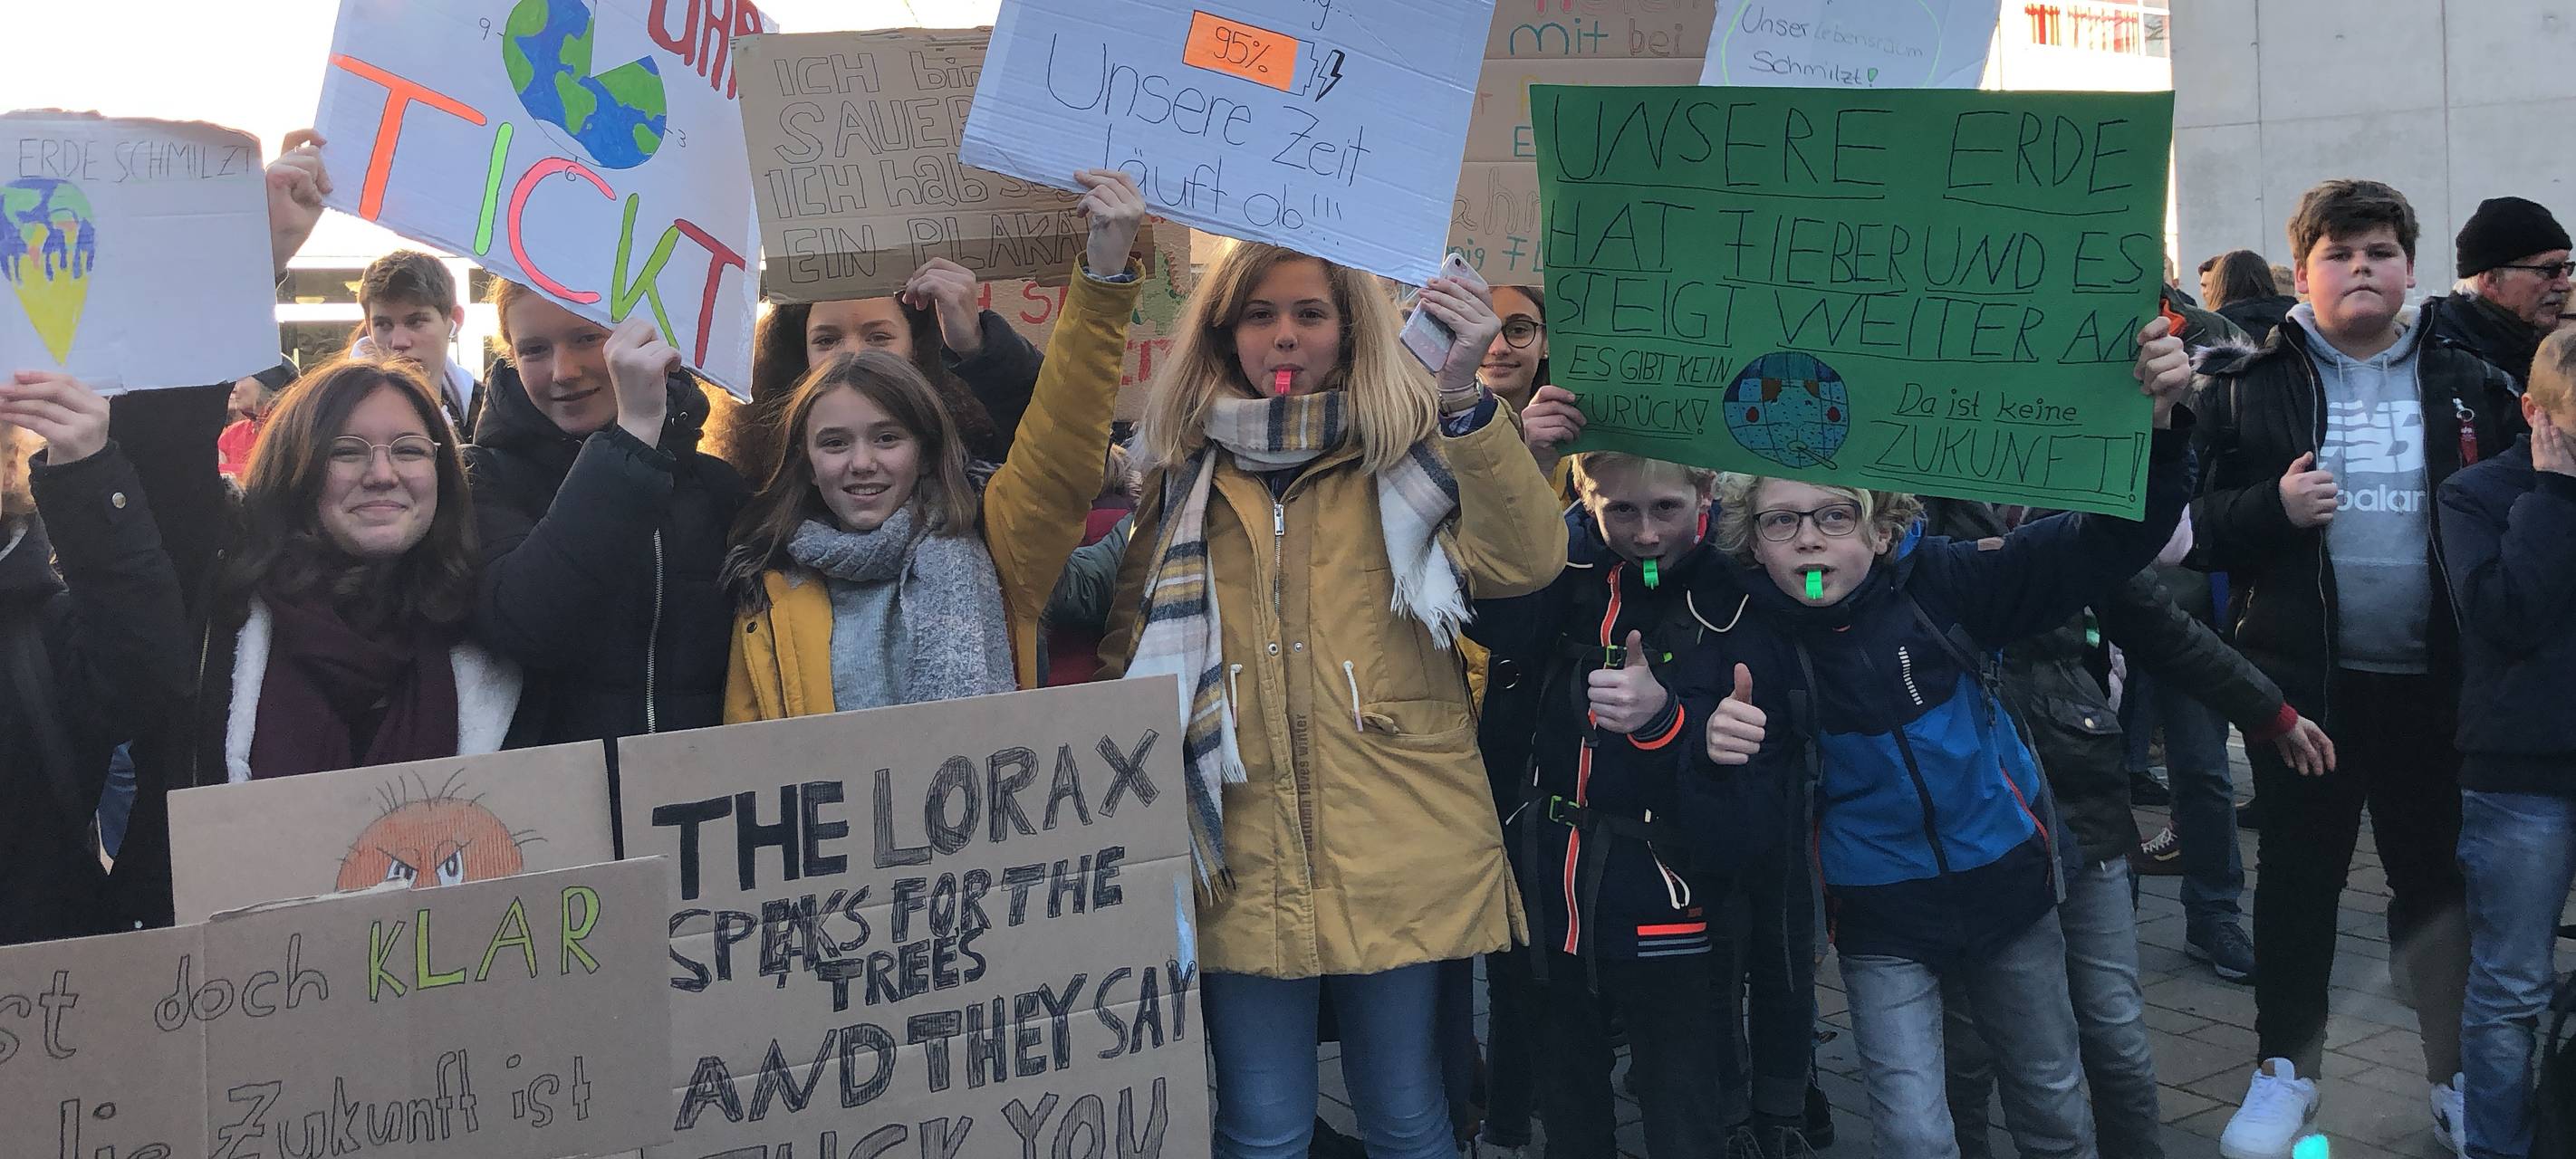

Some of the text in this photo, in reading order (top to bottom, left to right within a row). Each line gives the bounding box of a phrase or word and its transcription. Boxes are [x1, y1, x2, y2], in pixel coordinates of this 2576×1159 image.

[479, 18, 491, 40] 9
[1213, 26, 1271, 73] 95%
[1510, 18, 1683, 57] mit bei
[1741, 7, 1810, 40] Unser
[774, 53, 879, 96] ICH
[1047, 34, 1371, 187] Unsere Zeit
[18, 138, 100, 180] ERDE
[764, 163, 867, 219] ICH
[879, 153, 989, 207] hab
[1104, 123, 1228, 214] läuft
[1553, 94, 1894, 187] UNSERE
[1948, 110, 2133, 196] ERDE
[330, 53, 746, 369] TICKT
[784, 209, 1087, 283] EIN PLAKA
[1547, 199, 2153, 290] HAT FIEBER UND ES
[1557, 271, 1747, 345] STEIGT
[1774, 290, 2045, 361] WEITER
[1570, 345, 1734, 384] ES GIBT KEIN
[1897, 383, 2077, 421] Da ist keine
[1870, 419, 2146, 503] ZUKUNFT!
[1296, 714, 1309, 756] winter
[652, 728, 1160, 900] THE LORAX
[1299, 761, 1312, 795] loves
[891, 867, 992, 944] FOR
[1001, 846, 1125, 927] THE
[155, 933, 329, 1031] doch
[369, 886, 601, 1003] KLAR
[673, 959, 1197, 1130] AND THEY SAY
[209, 1049, 479, 1159] Zukunft
[506, 1054, 591, 1128] ist
[1001, 1077, 1167, 1159] YOU
